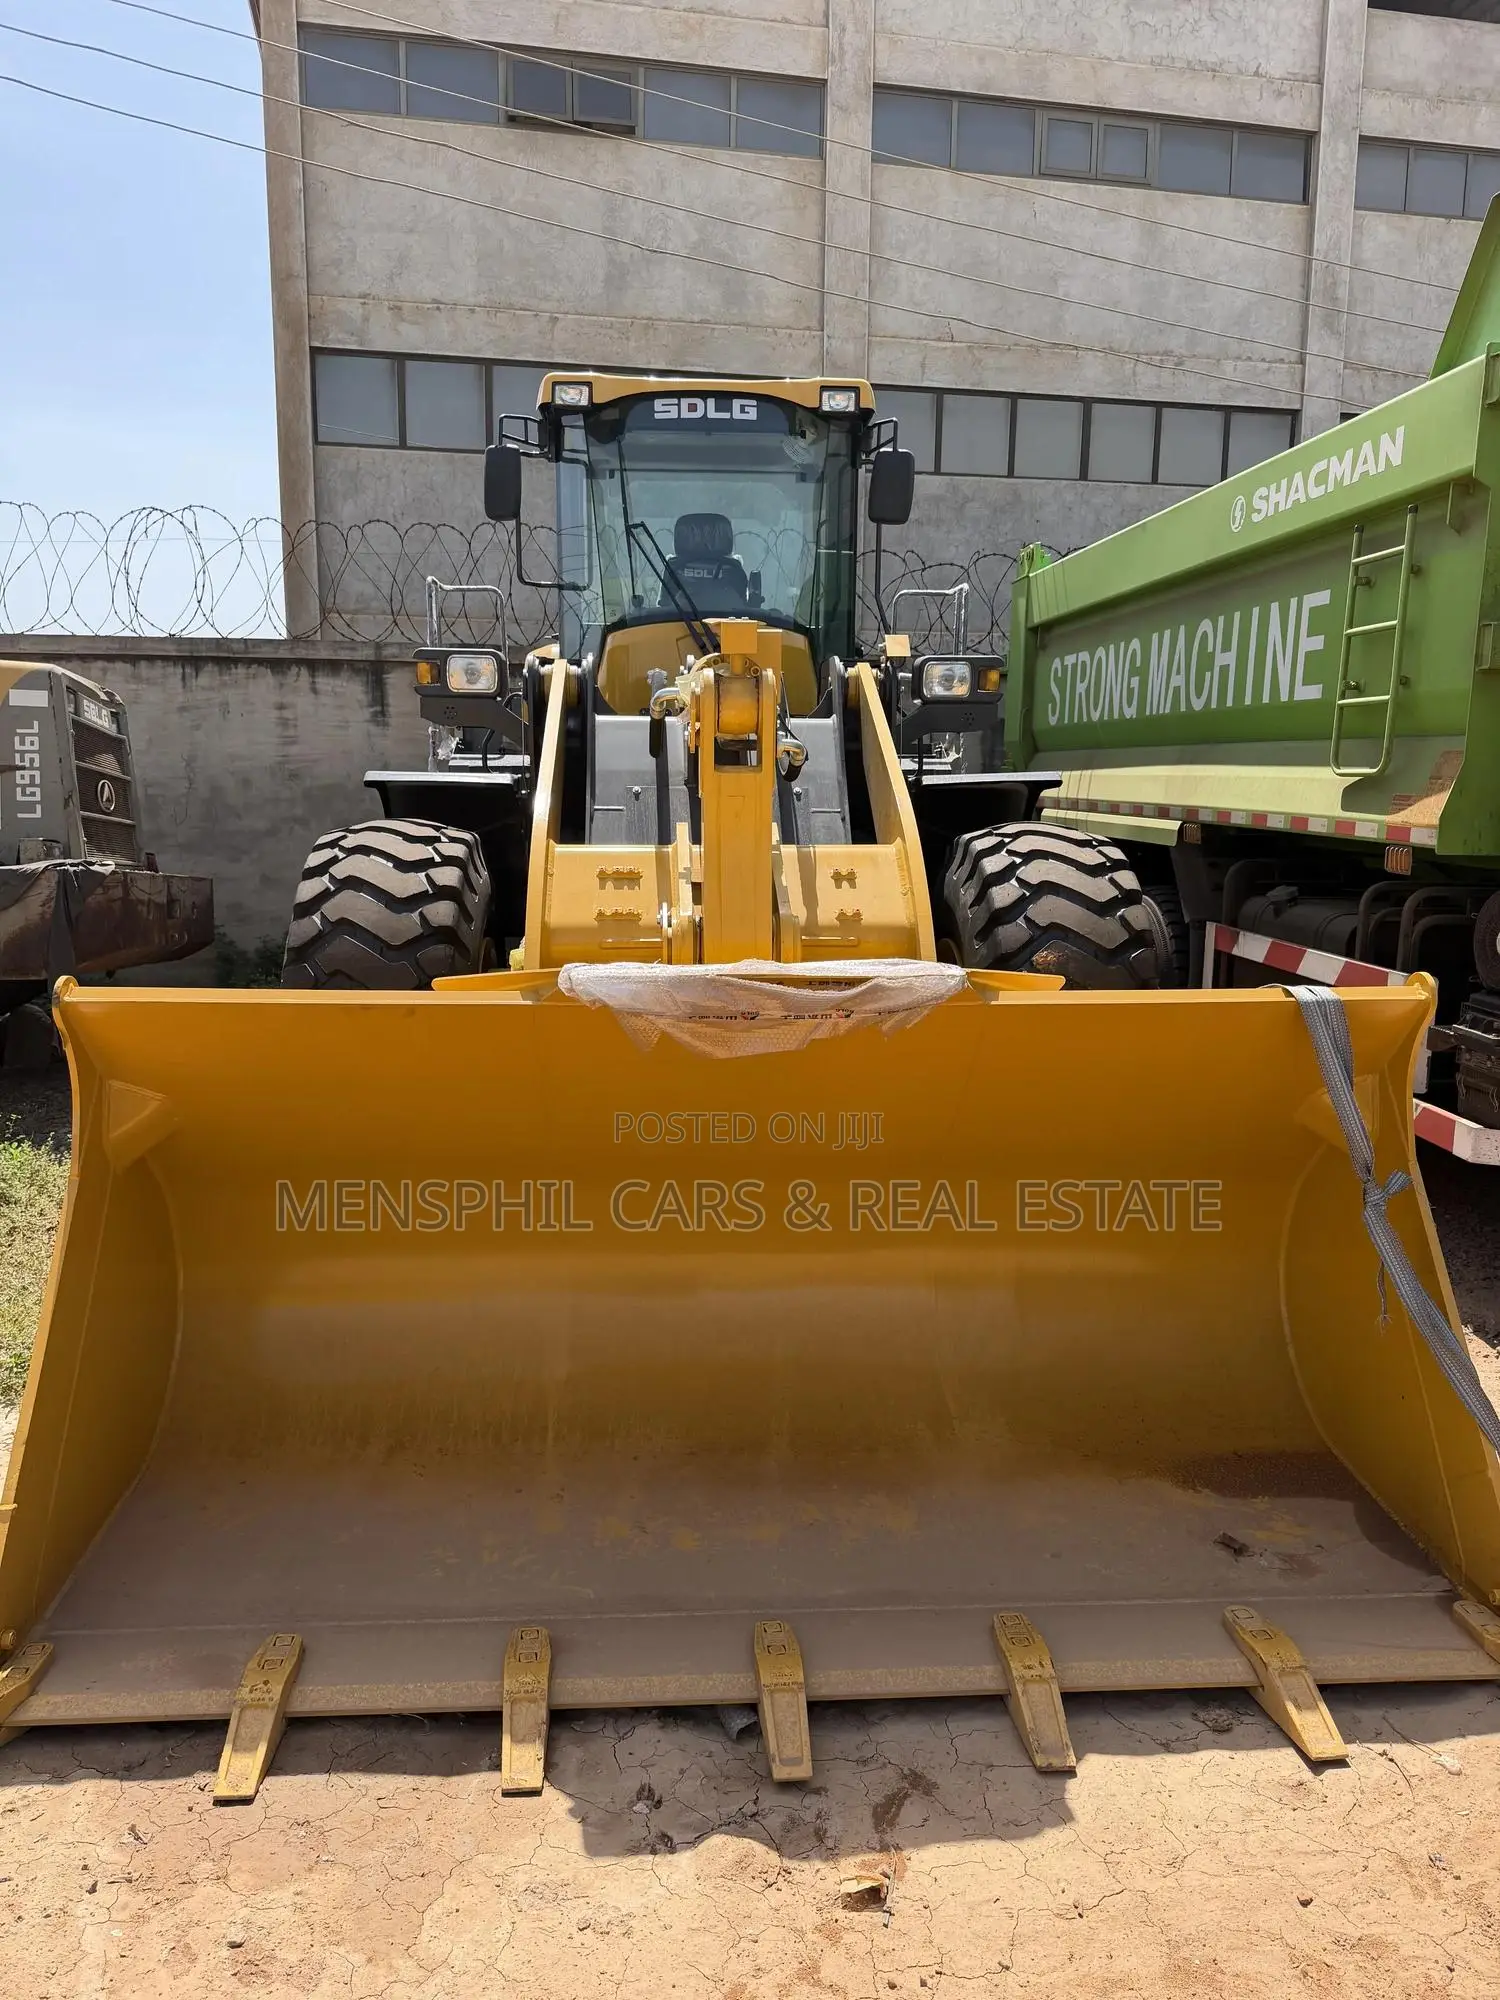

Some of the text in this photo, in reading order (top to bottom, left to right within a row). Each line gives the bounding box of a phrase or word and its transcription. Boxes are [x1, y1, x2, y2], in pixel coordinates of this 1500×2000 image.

[653, 397, 758, 420] SDLG
[1250, 426, 1405, 523] SHACMAN
[1047, 588, 1331, 726] STRONG MACHINE
[14, 720, 41, 818] LG956L
